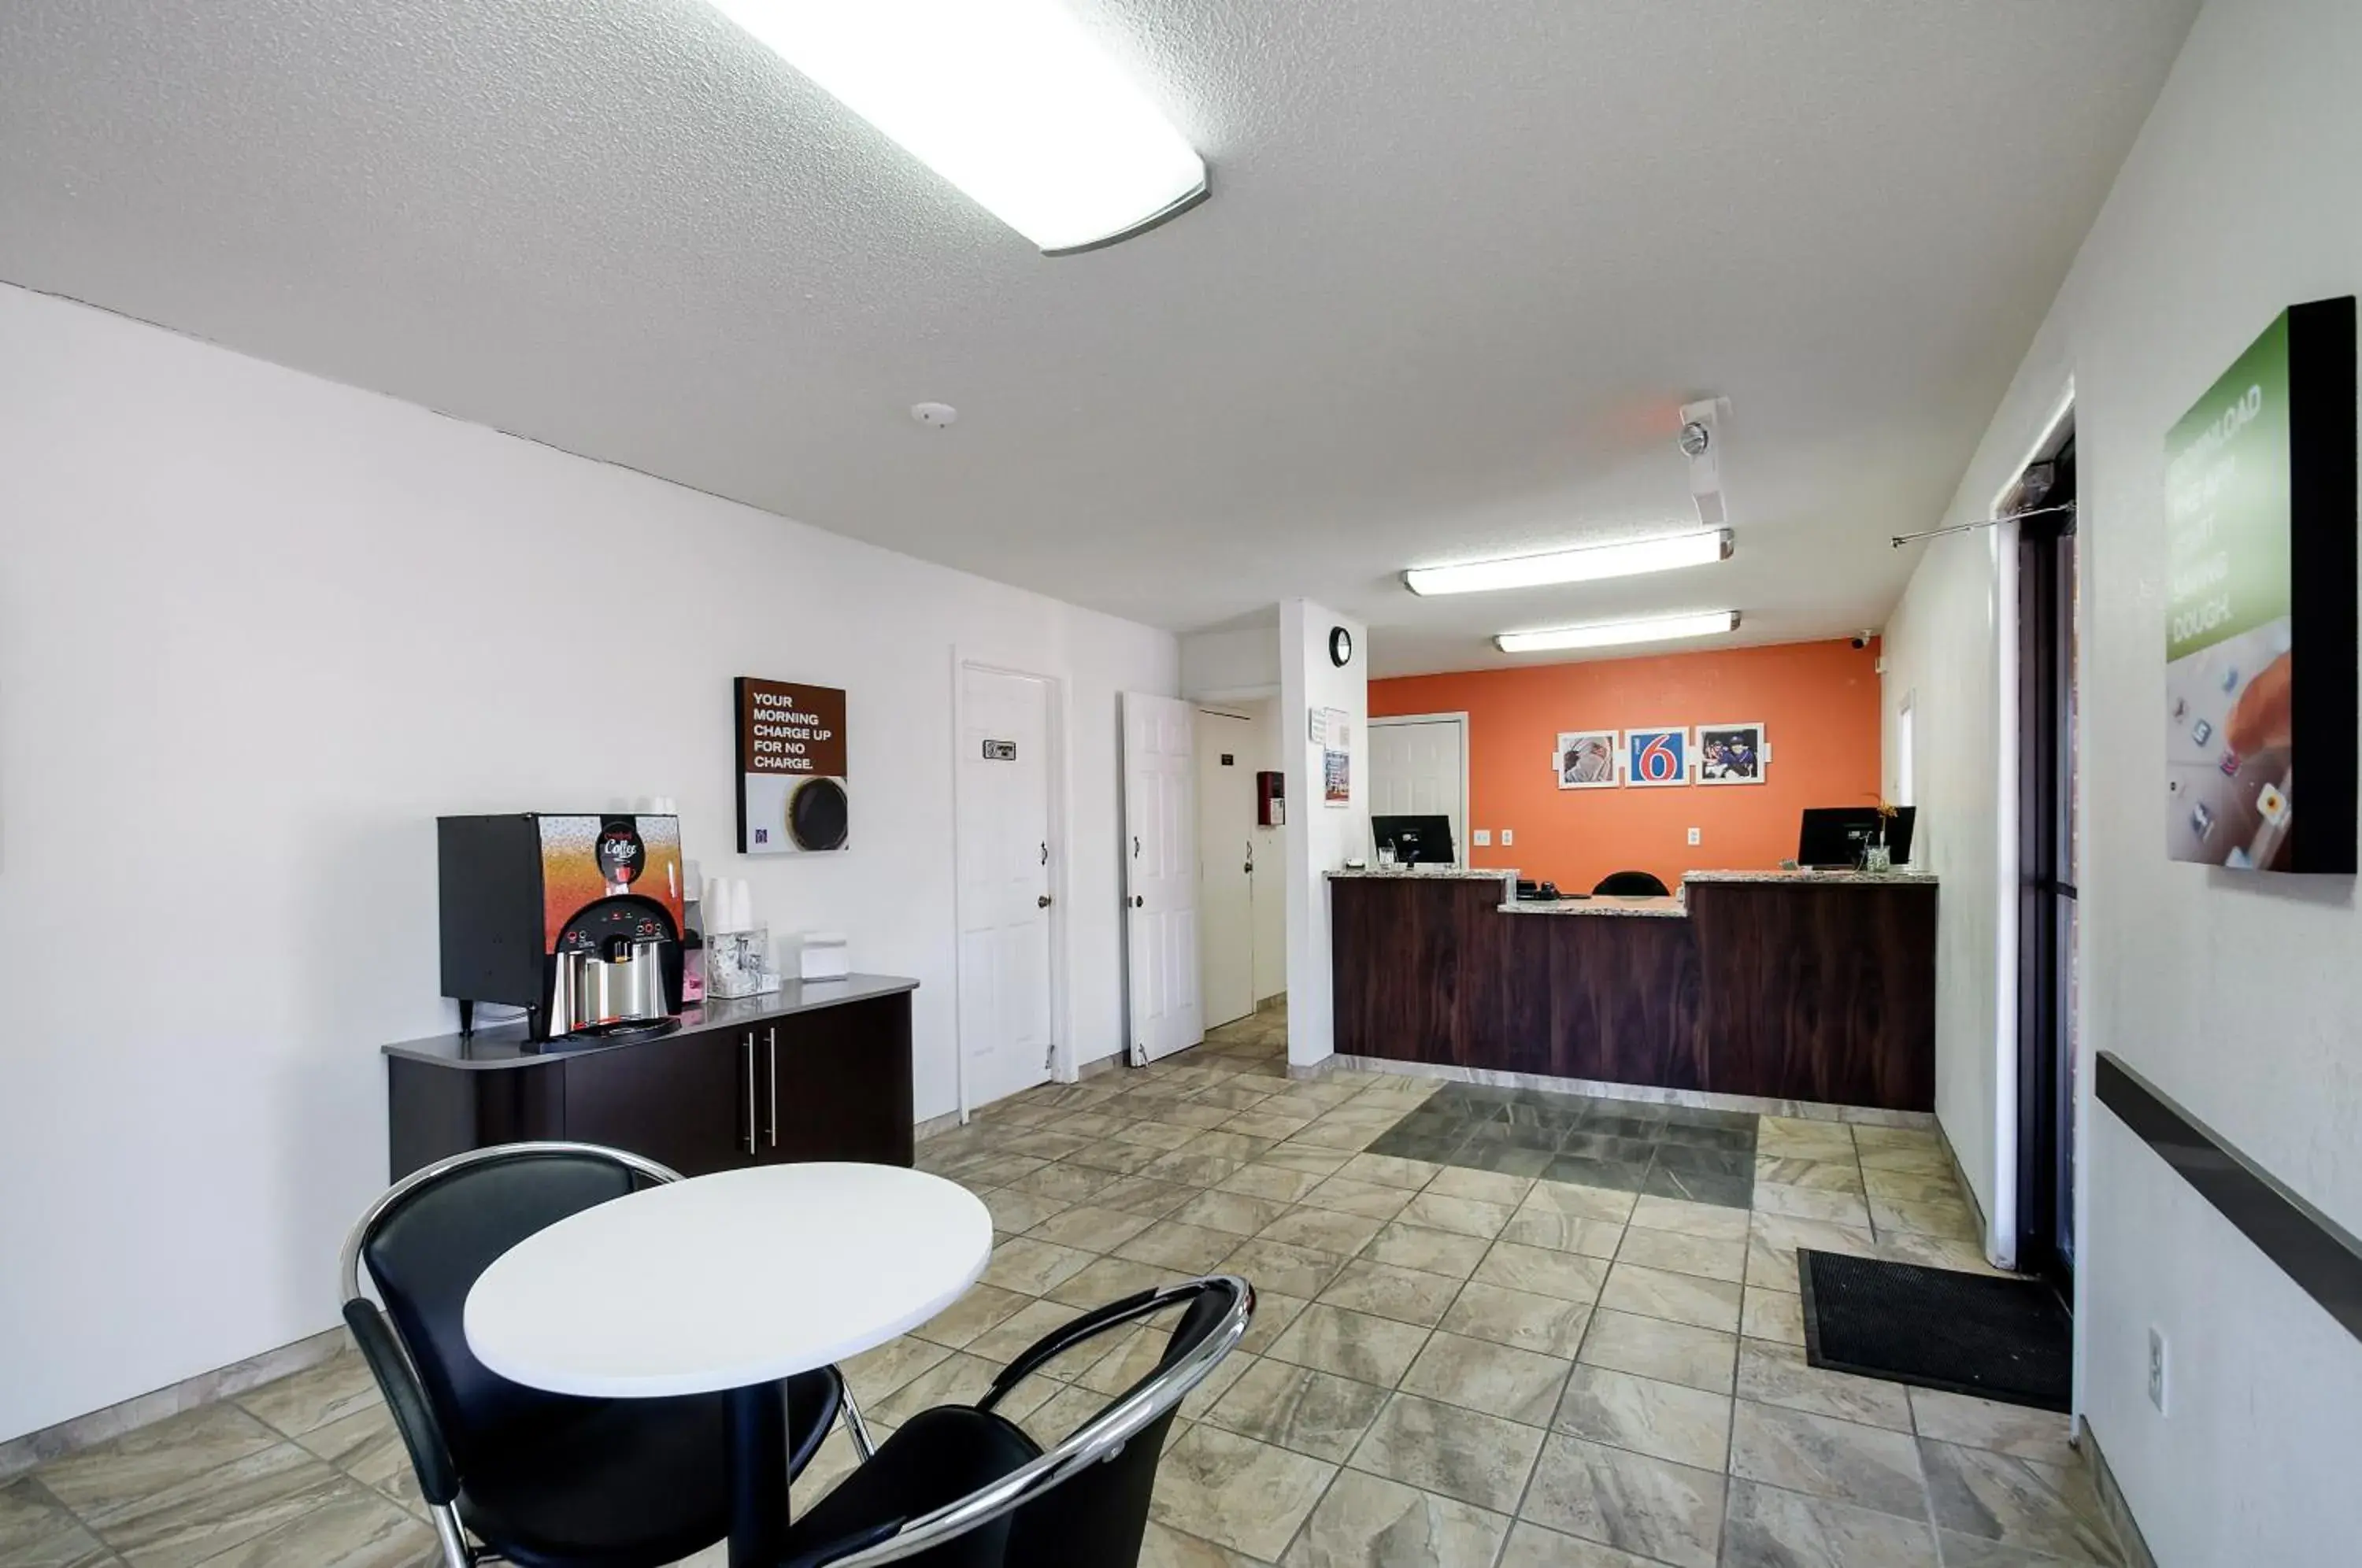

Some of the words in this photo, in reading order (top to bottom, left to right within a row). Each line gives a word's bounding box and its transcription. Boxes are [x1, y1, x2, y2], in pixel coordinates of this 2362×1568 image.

[2170, 383, 2262, 488] NLOAD
[753, 693, 793, 707] YOUR
[753, 709, 819, 725] MORNING
[753, 724, 809, 740] CHARGE
[813, 730, 831, 740] UP
[754, 740, 783, 753] FOR
[785, 742, 805, 754] NO
[754, 756, 813, 769] CHARGE.
[1639, 734, 1677, 782] 6
[605, 839, 636, 858] Coffee
